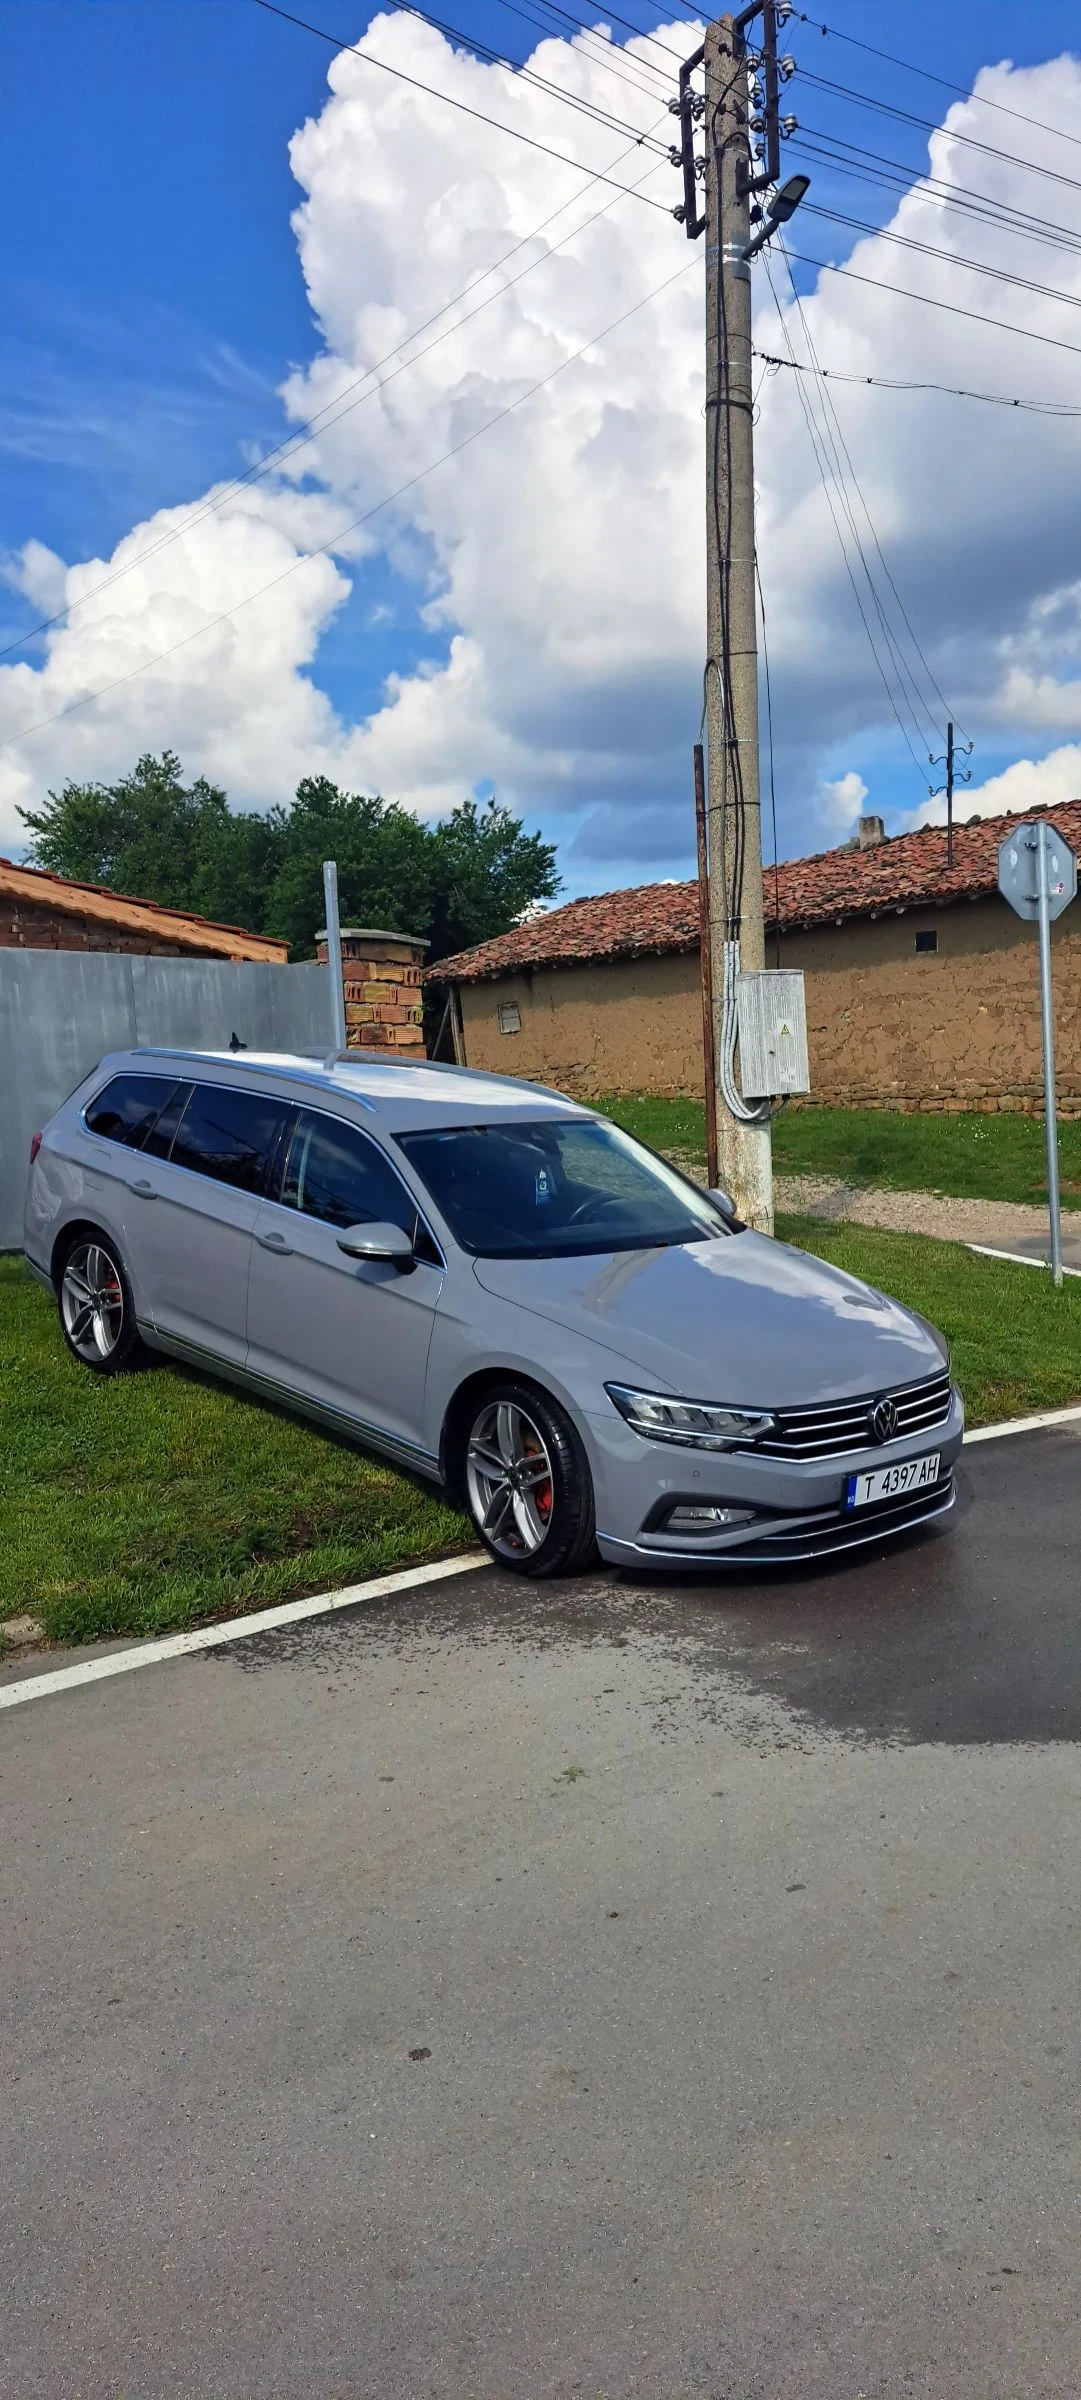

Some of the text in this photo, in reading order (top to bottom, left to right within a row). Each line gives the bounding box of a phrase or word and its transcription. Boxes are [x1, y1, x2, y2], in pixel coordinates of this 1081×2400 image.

[874, 1399, 898, 1440] VW
[865, 1457, 938, 1499] T 4397 AH
